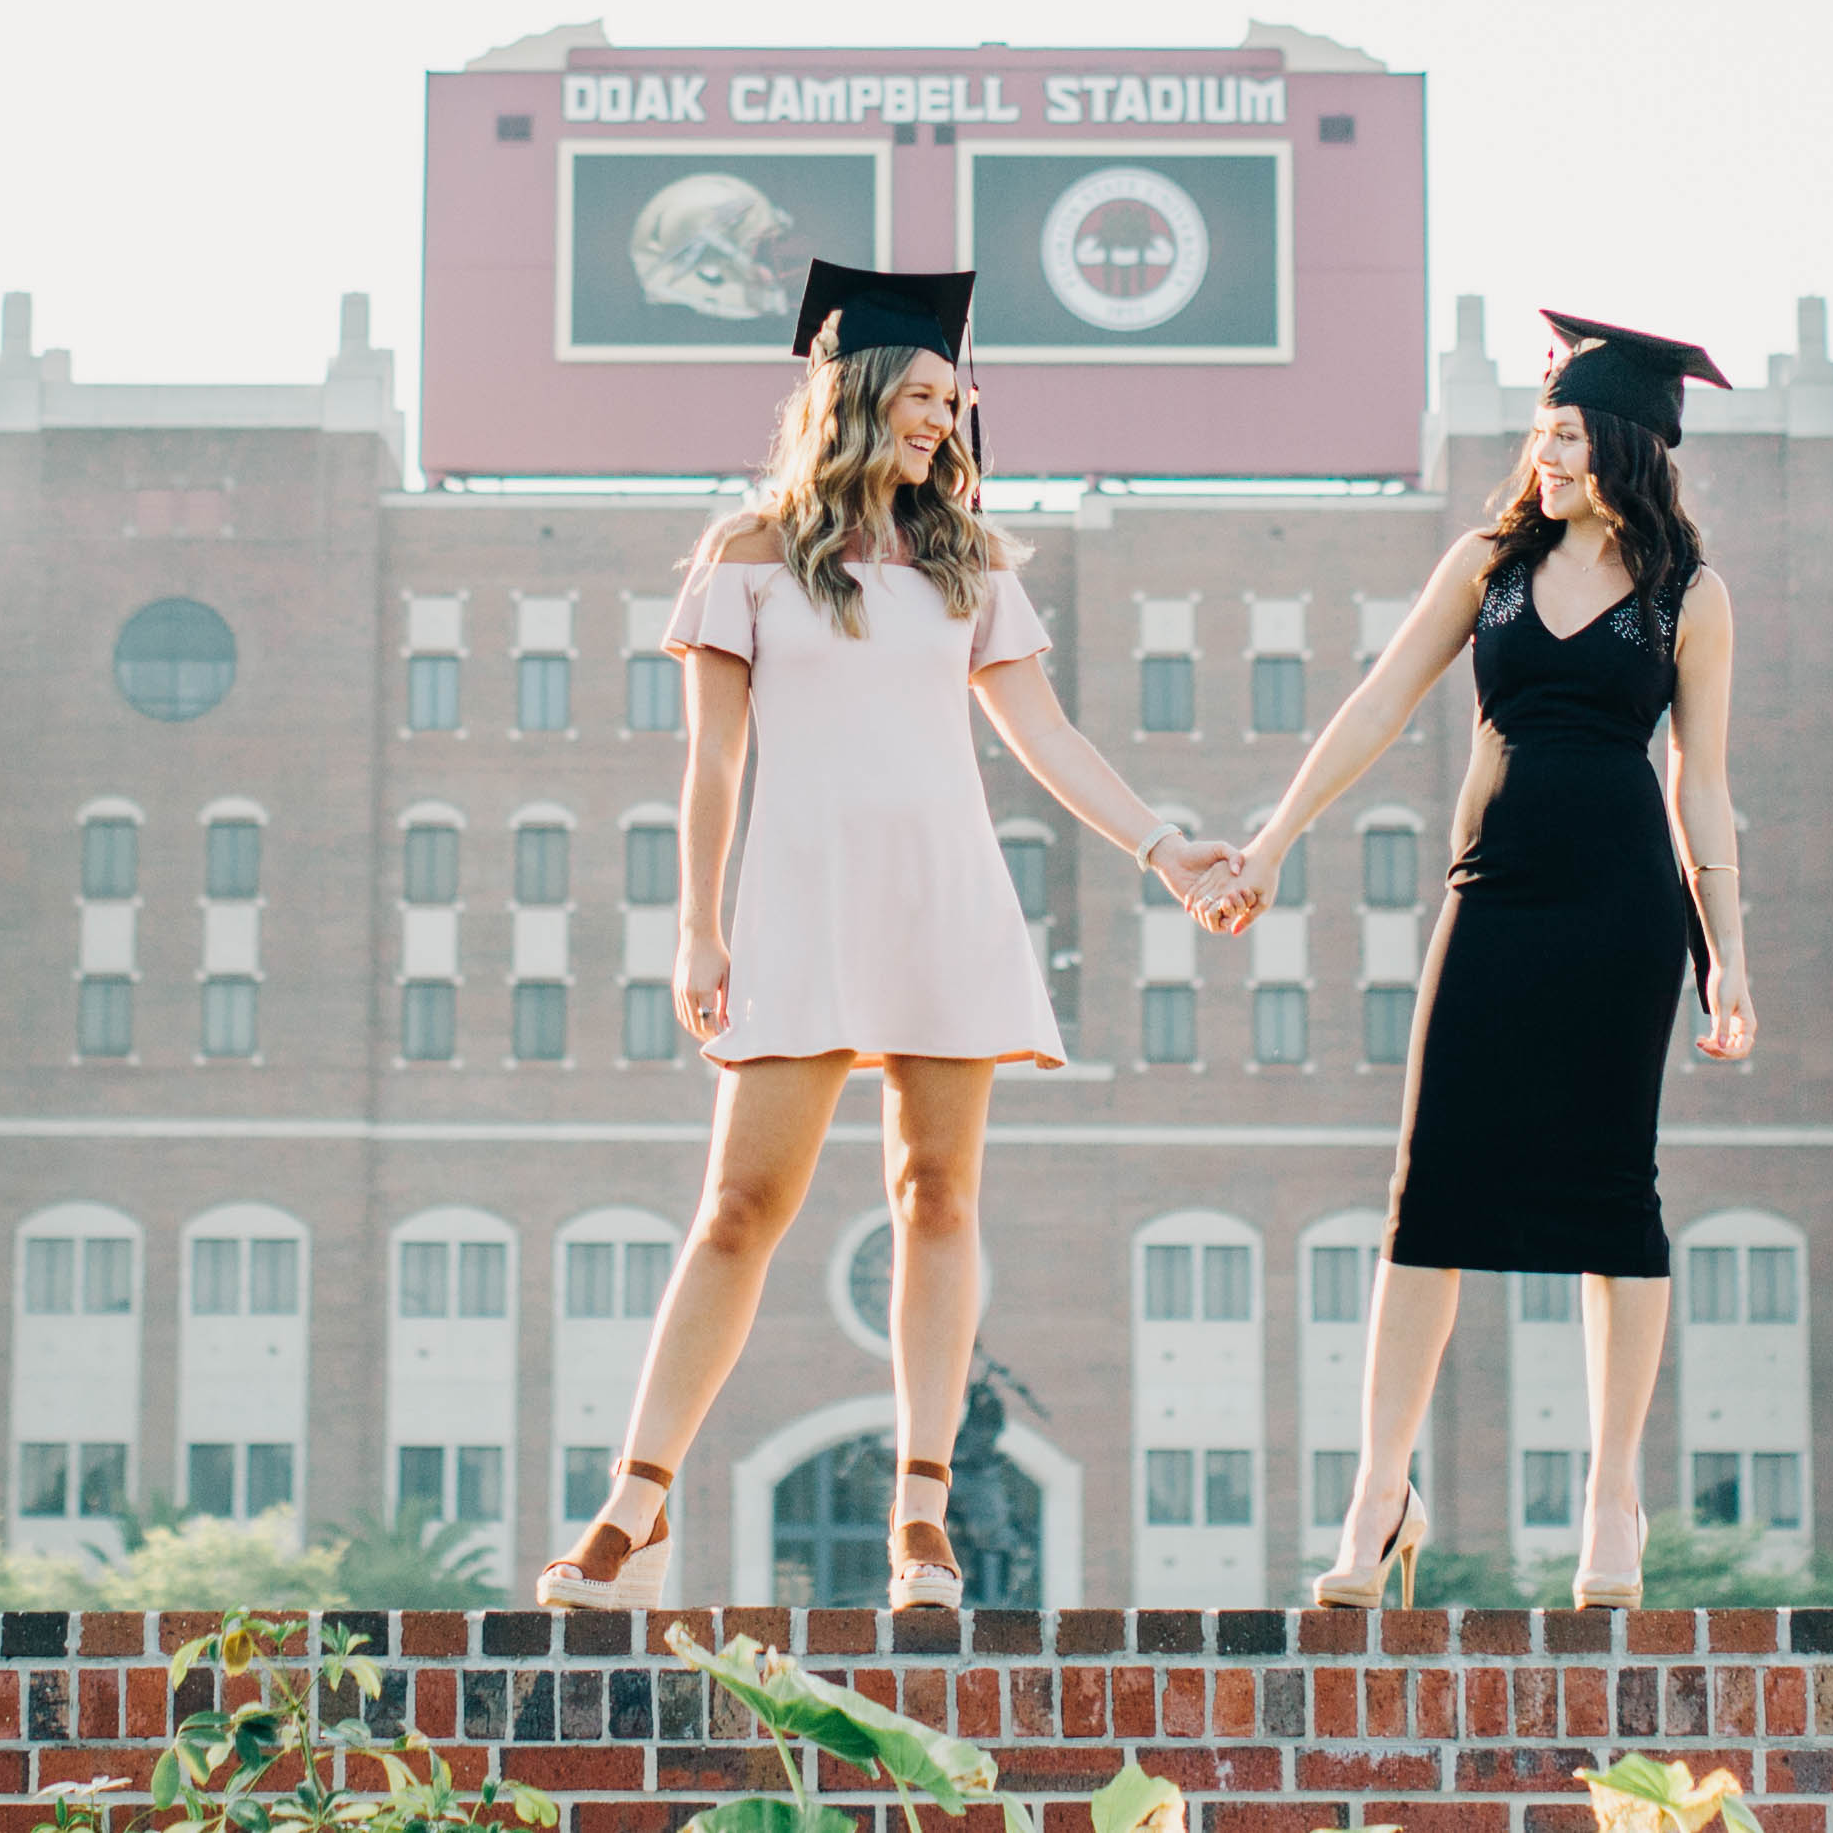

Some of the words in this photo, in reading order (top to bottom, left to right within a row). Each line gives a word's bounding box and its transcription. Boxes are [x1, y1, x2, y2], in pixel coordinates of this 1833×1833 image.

[564, 74, 706, 123] DOAK
[729, 75, 1021, 123] CAMPBELL
[1045, 75, 1286, 123] STADIUM
